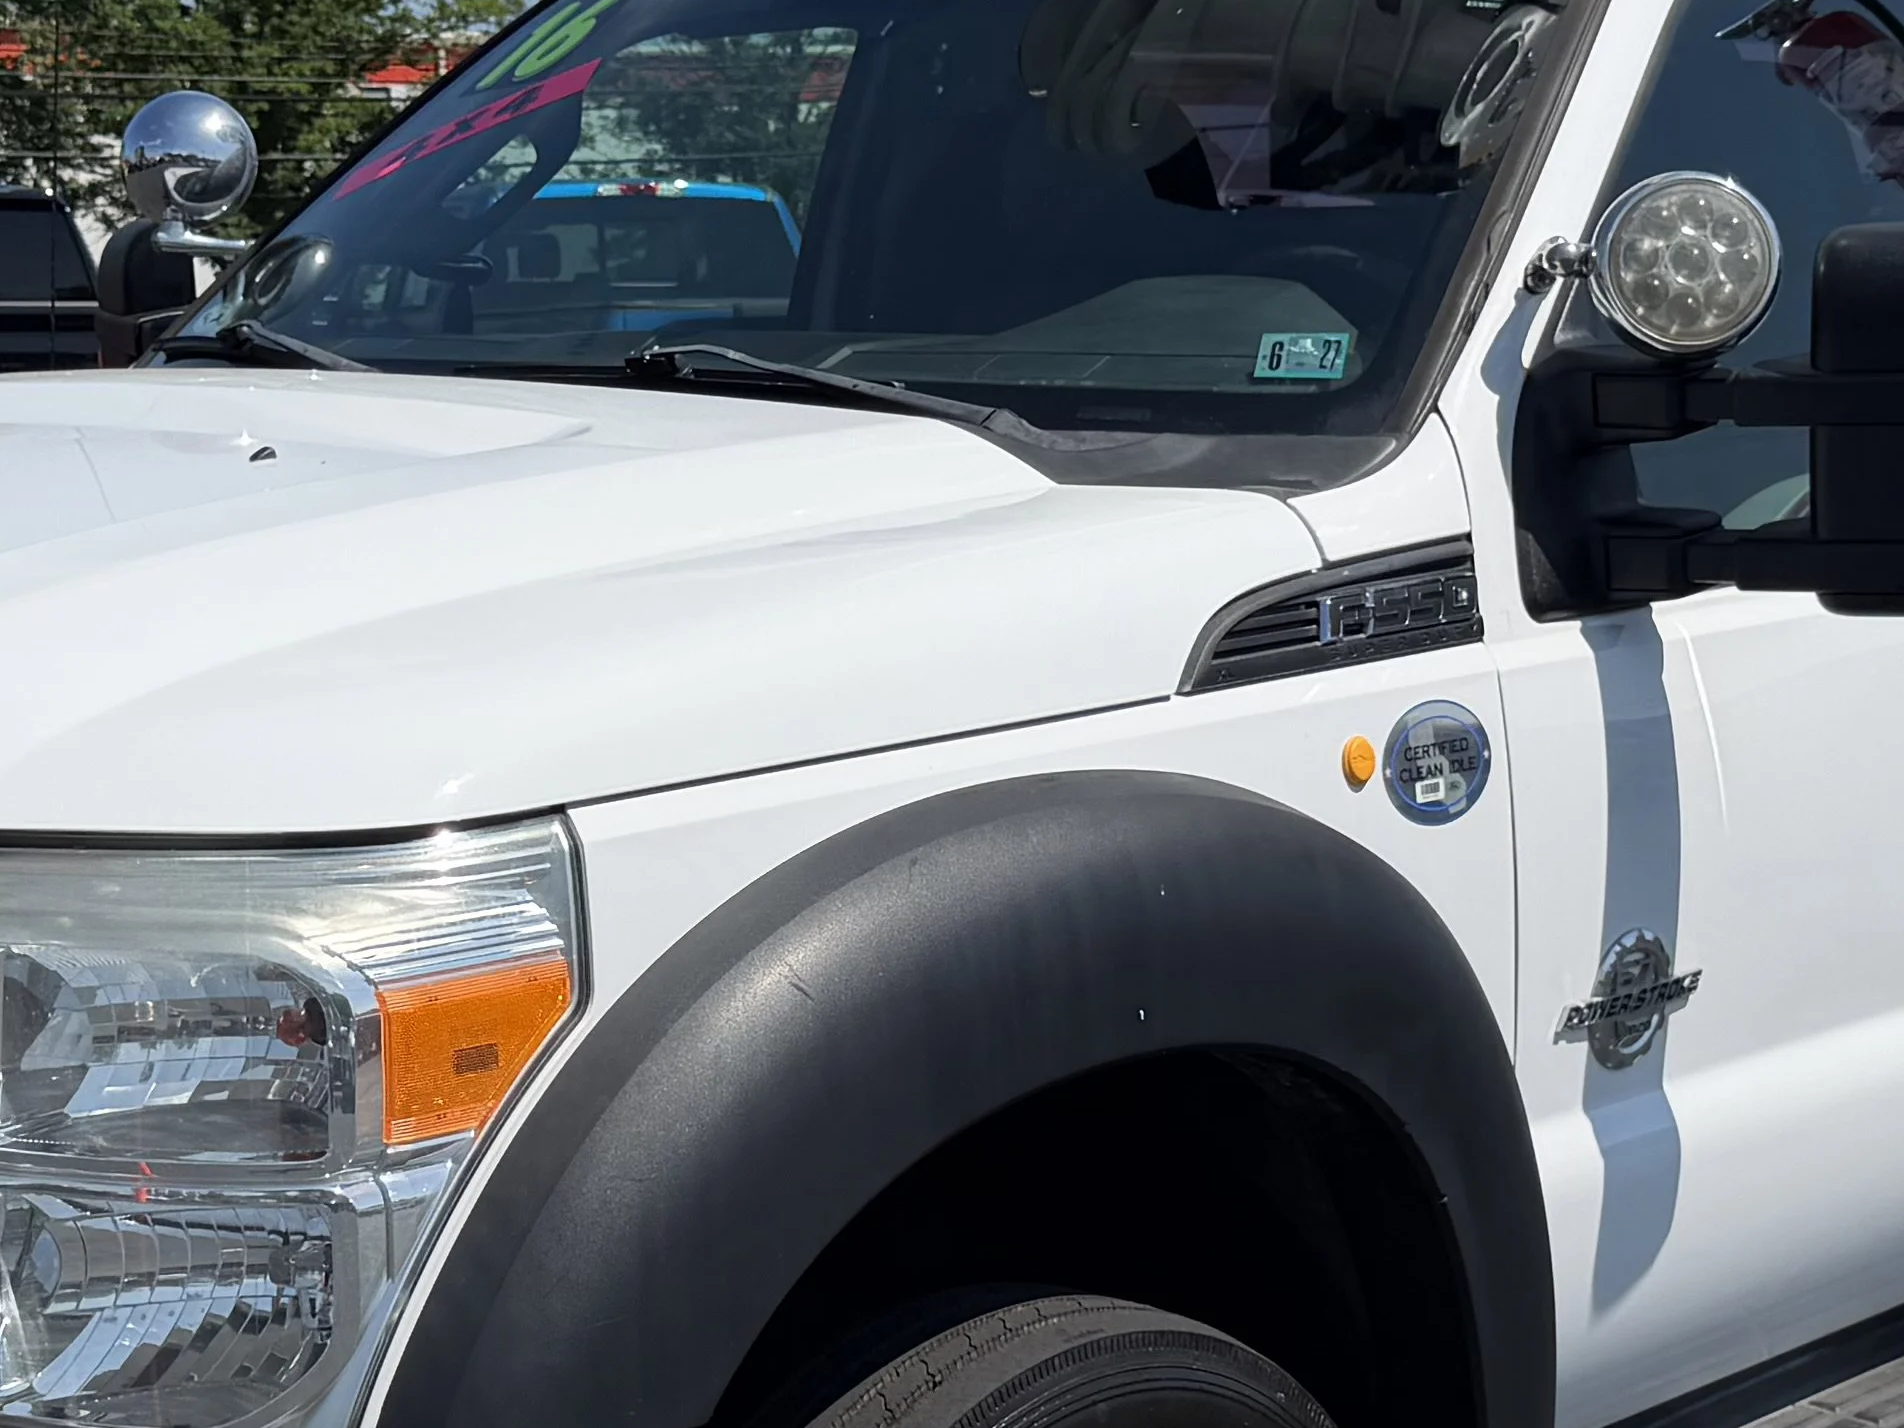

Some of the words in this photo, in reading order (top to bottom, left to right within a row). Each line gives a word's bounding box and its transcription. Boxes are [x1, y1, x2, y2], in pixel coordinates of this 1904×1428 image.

[1268, 340, 1284, 371] 6
[1318, 339, 1342, 370] 27
[1404, 737, 1469, 762] CERTIFIED
[1399, 762, 1443, 784] CLEAN
